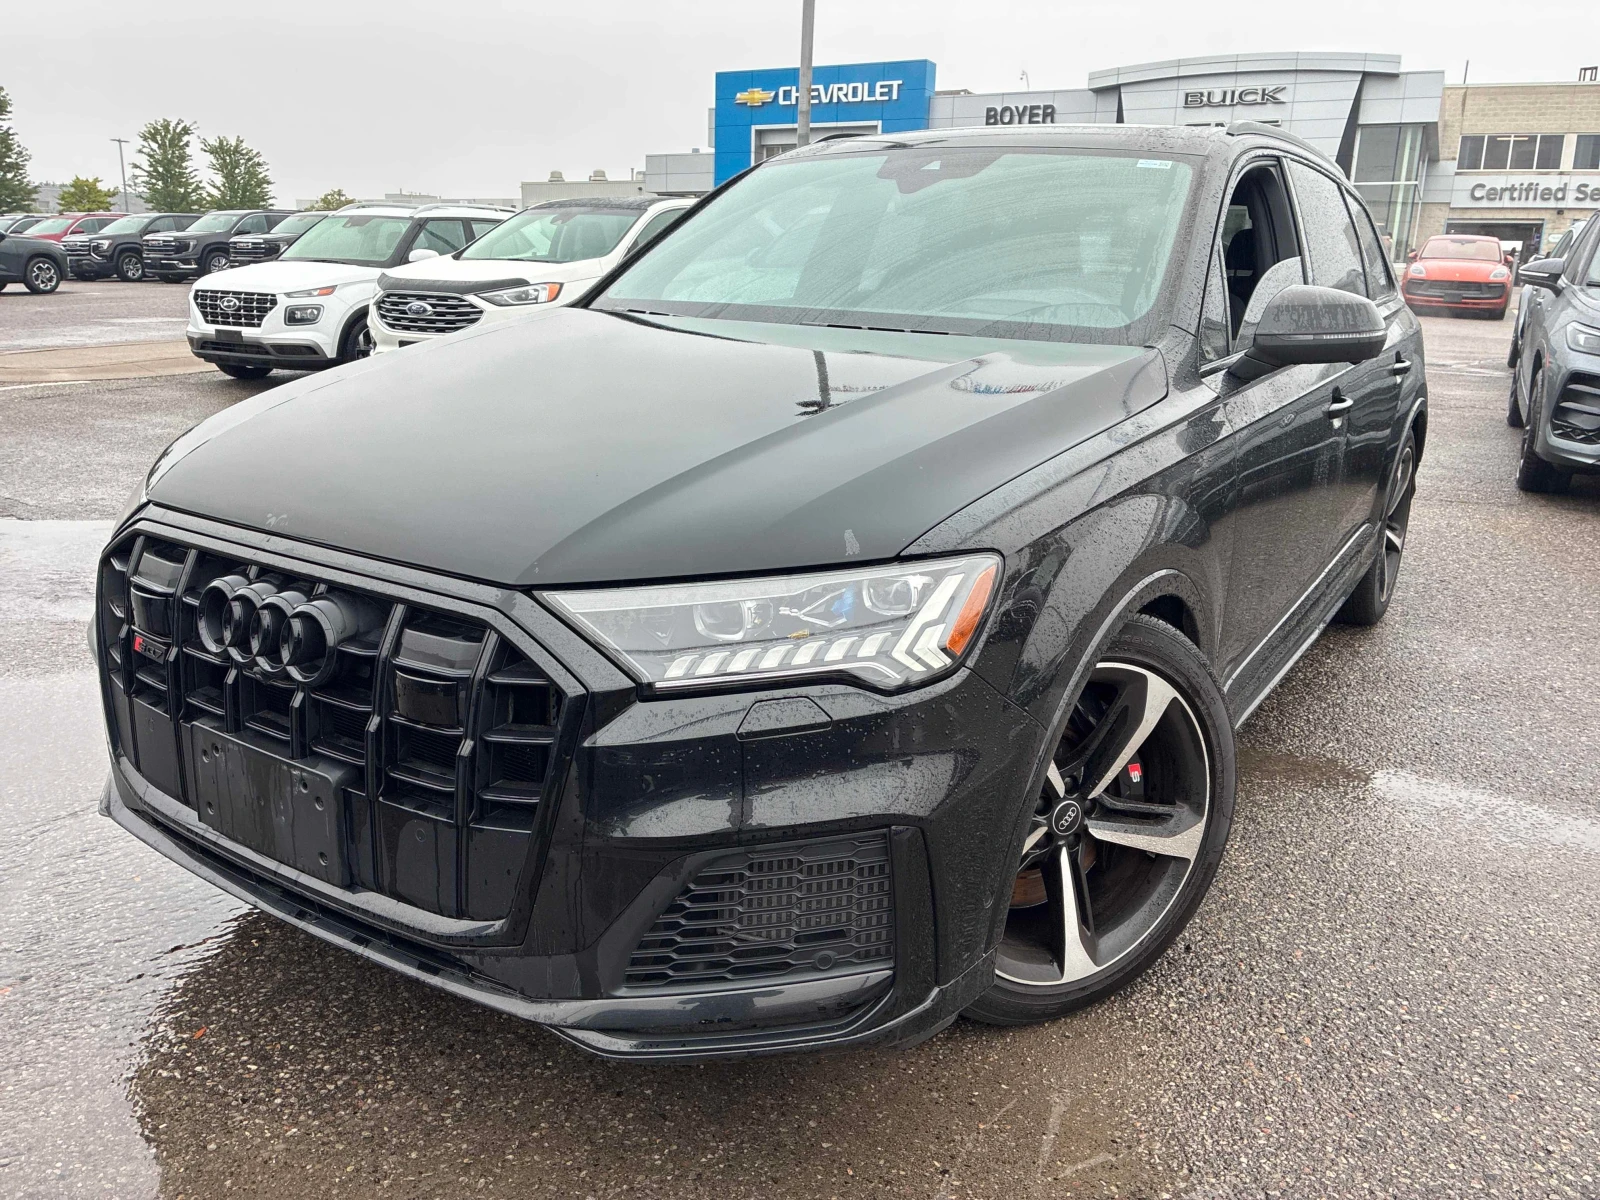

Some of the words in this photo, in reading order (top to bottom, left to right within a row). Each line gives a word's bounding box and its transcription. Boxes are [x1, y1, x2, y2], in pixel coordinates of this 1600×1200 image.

[778, 80, 903, 105] CHEVROLET
[1183, 86, 1287, 108] BUICK
[985, 104, 1056, 126] BOYER
[1470, 182, 1568, 202] Certified
[1575, 183, 1600, 202] Se
